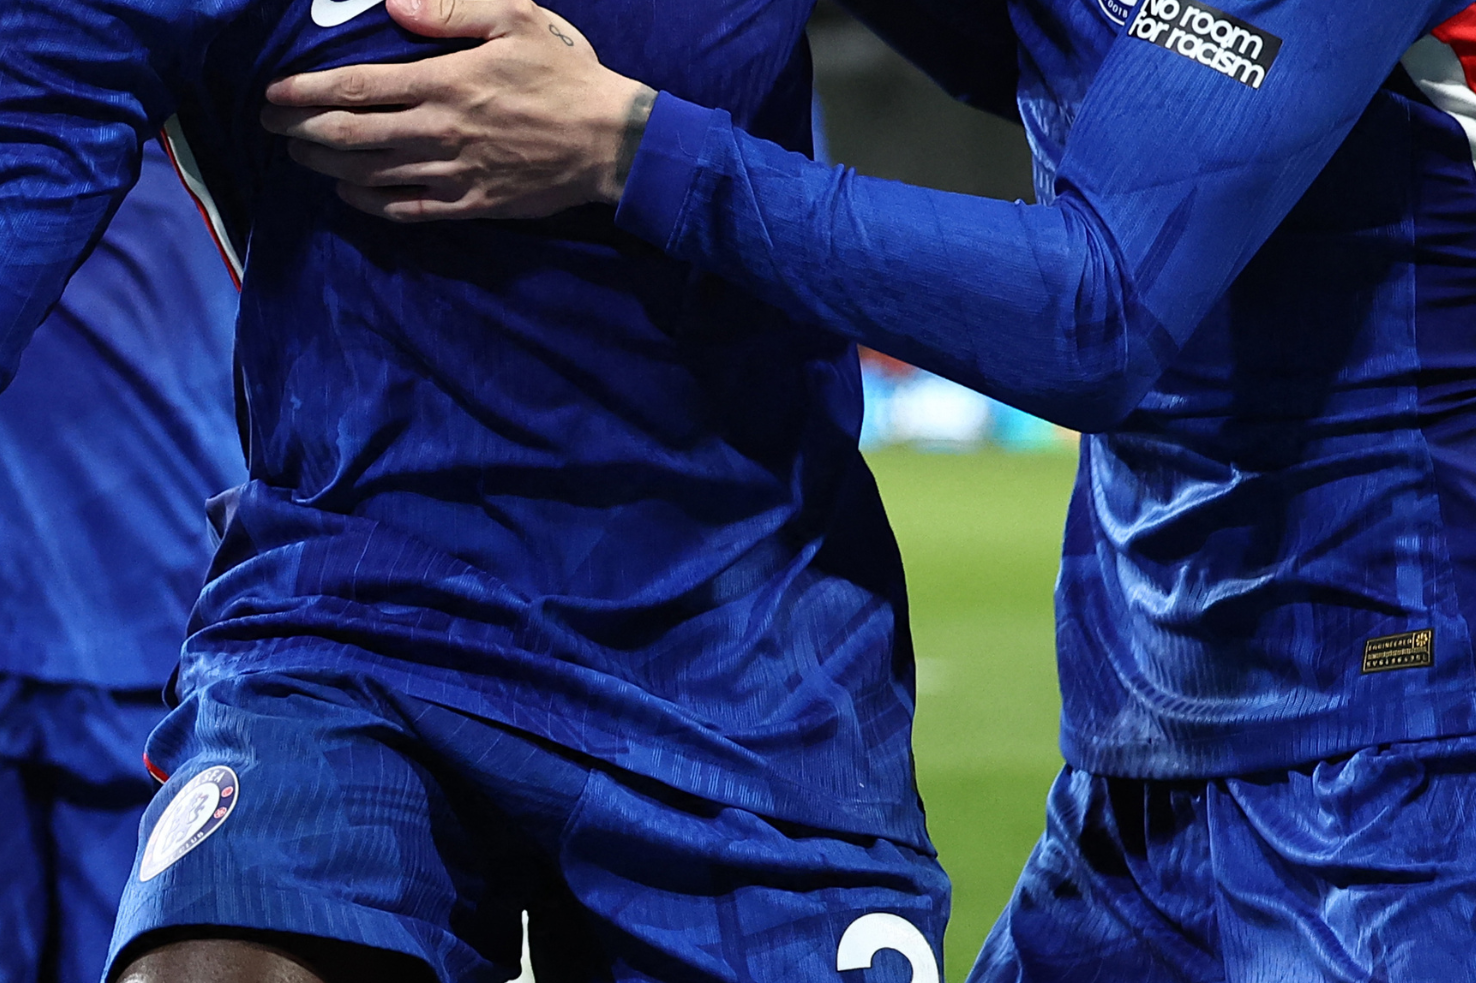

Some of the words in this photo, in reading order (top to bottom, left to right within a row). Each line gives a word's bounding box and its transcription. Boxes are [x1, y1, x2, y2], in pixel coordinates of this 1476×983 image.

[1128, 11, 1170, 42] for
[1165, 27, 1266, 89] racism
[1179, 5, 1264, 60] room
